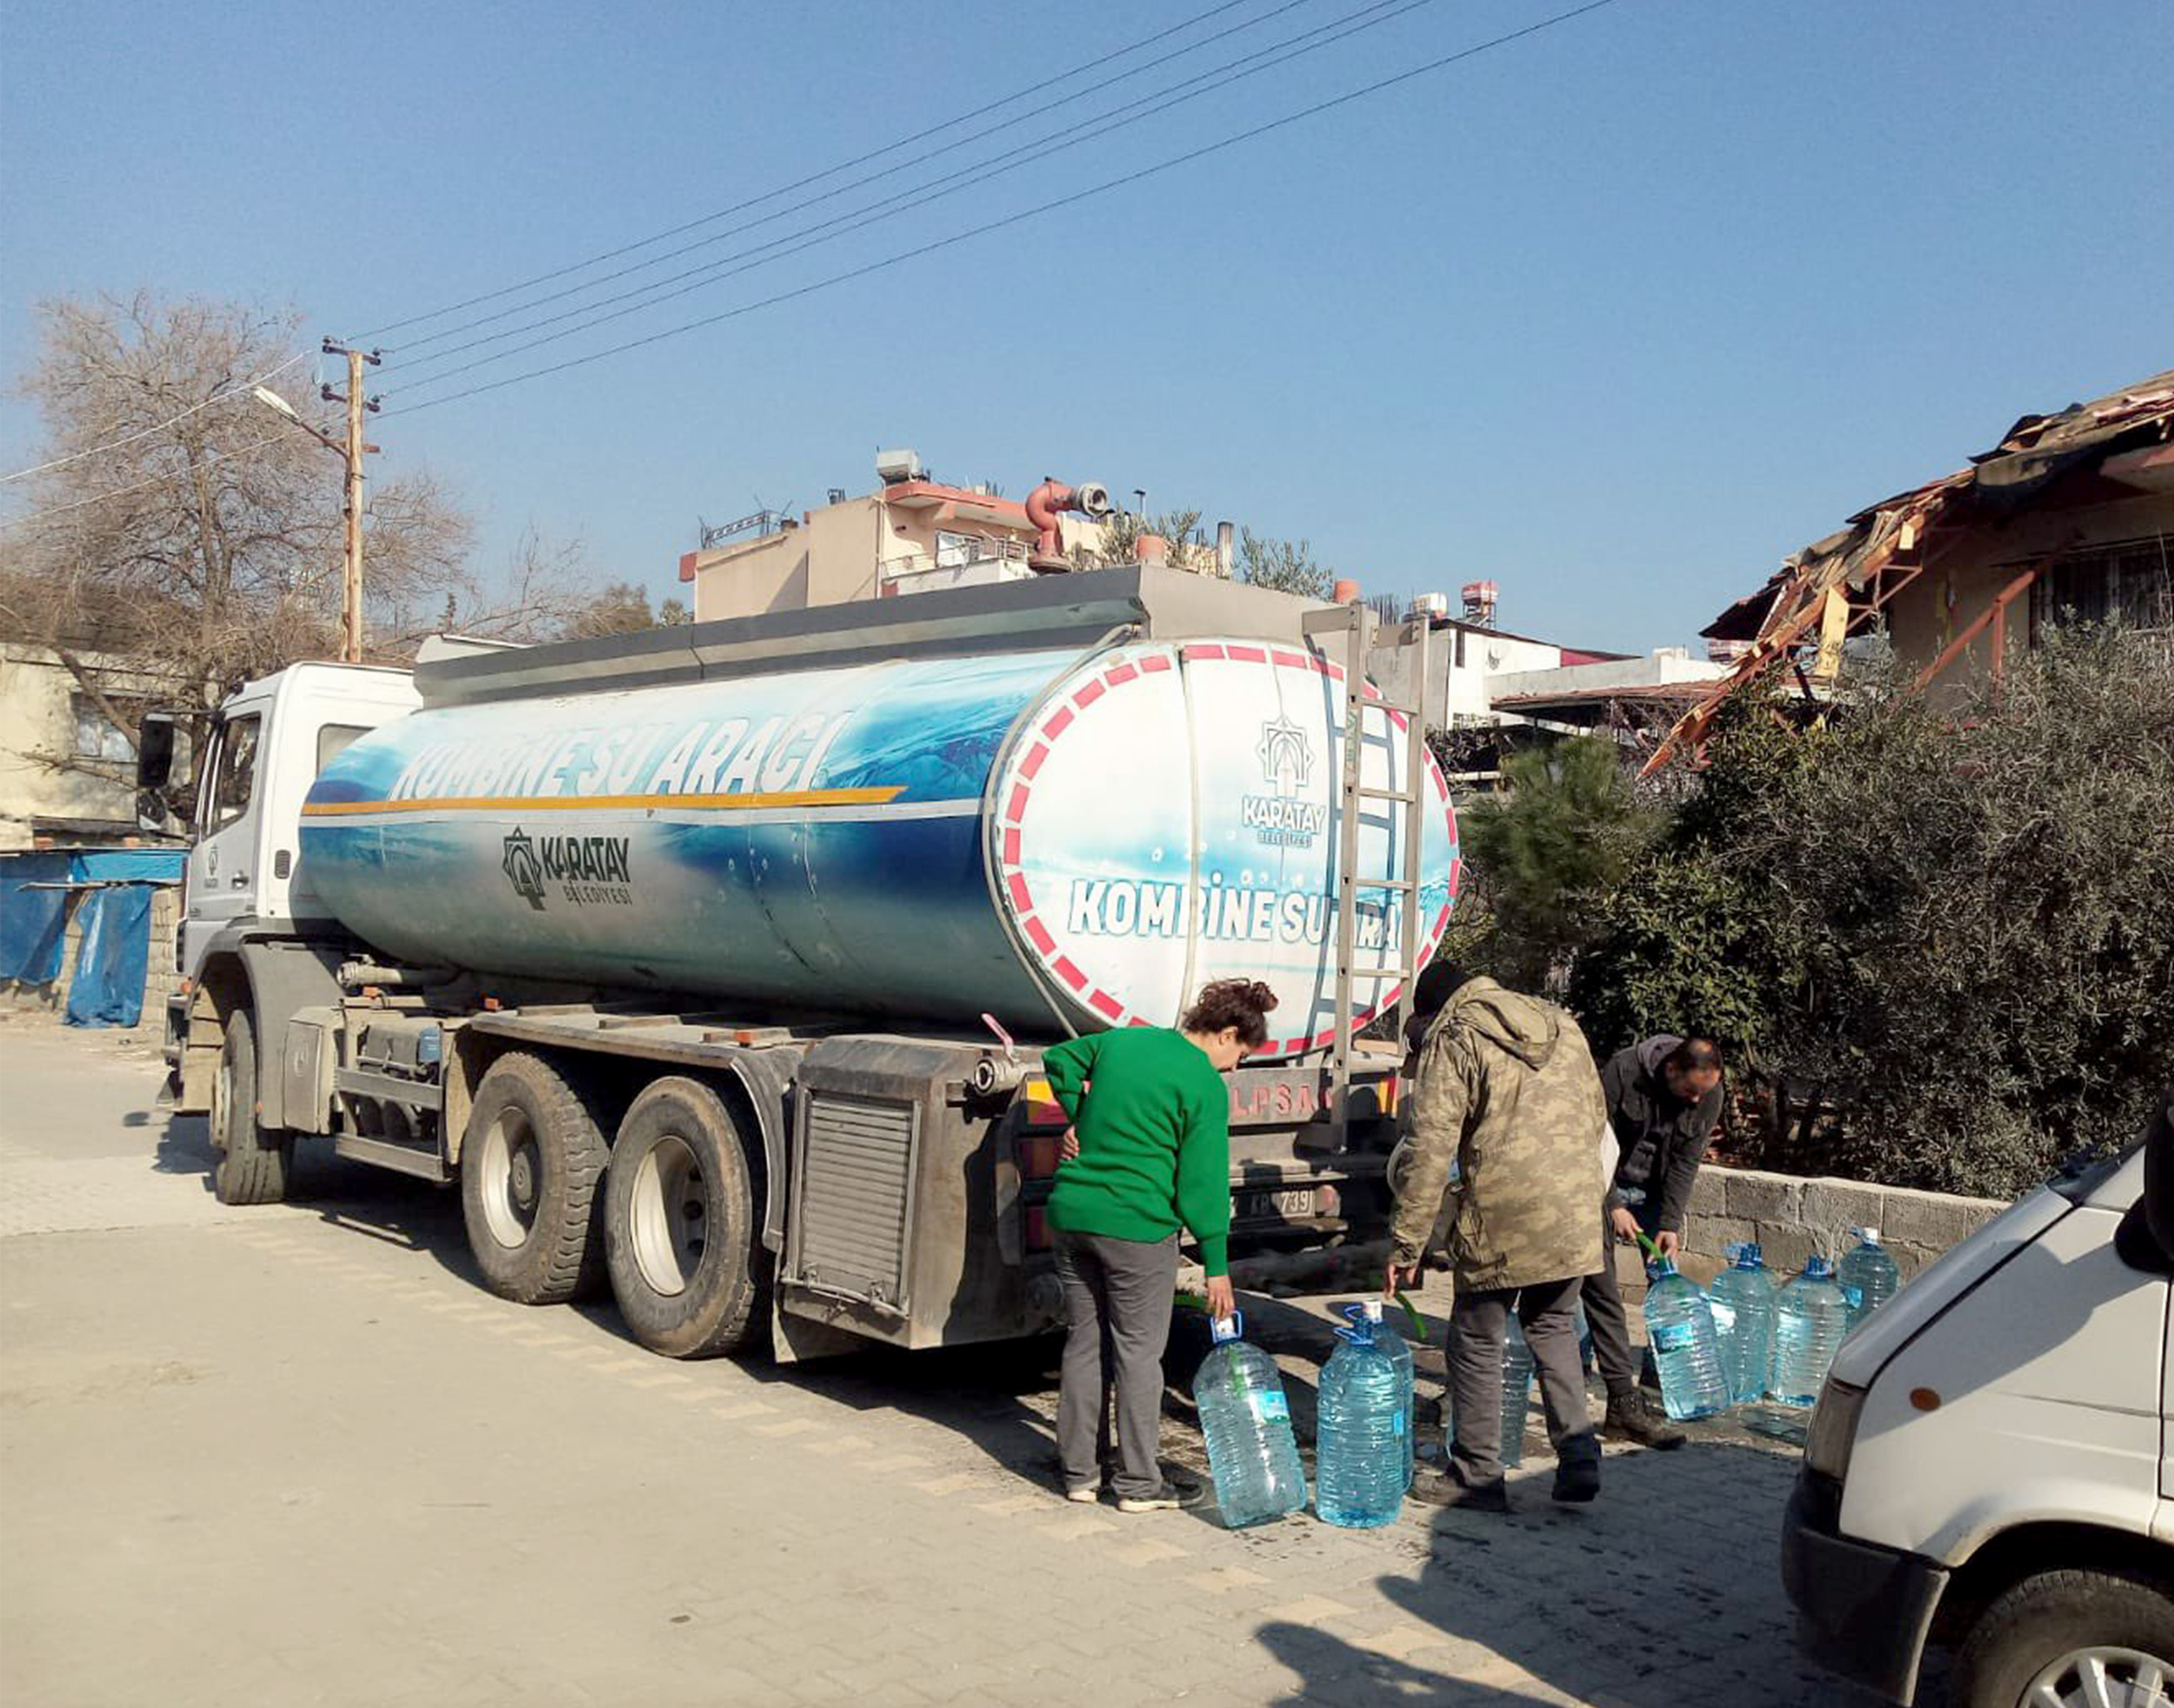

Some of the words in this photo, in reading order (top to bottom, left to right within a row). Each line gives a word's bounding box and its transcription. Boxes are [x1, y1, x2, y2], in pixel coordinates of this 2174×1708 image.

[572, 723, 670, 795] SU
[644, 709, 856, 795] ARACI
[1242, 795, 1326, 836] KARATAY
[540, 837, 631, 883] KARATAY
[1068, 871, 1277, 942] KOMBİNE
[1280, 891, 1330, 945] SU
